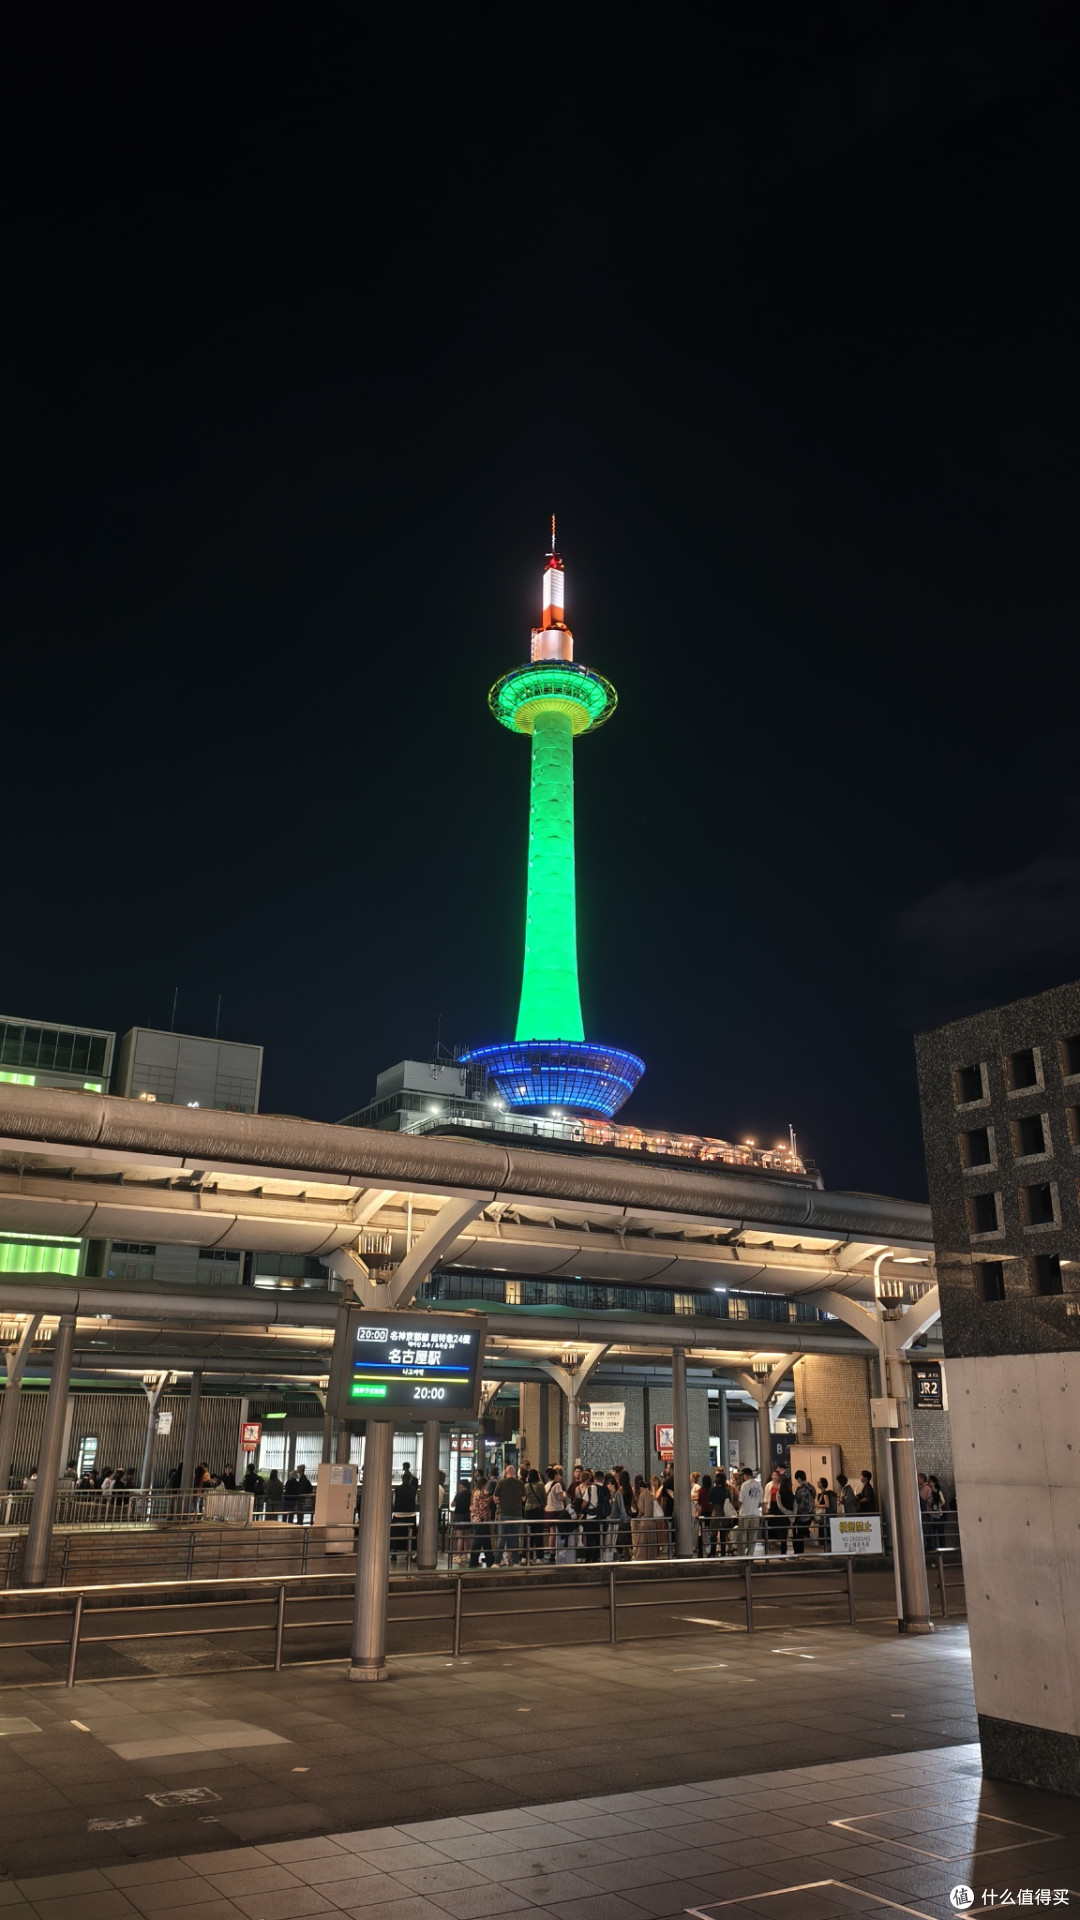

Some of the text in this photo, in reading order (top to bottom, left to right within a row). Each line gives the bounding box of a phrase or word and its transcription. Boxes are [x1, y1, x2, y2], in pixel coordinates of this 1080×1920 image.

[360, 1330, 386, 1340] 20:00
[388, 1349, 442, 1365] 名古屋駅
[413, 1387, 445, 1399] 20:00
[462, 1440, 473, 1448] A2
[776, 1443, 783, 1455] B
